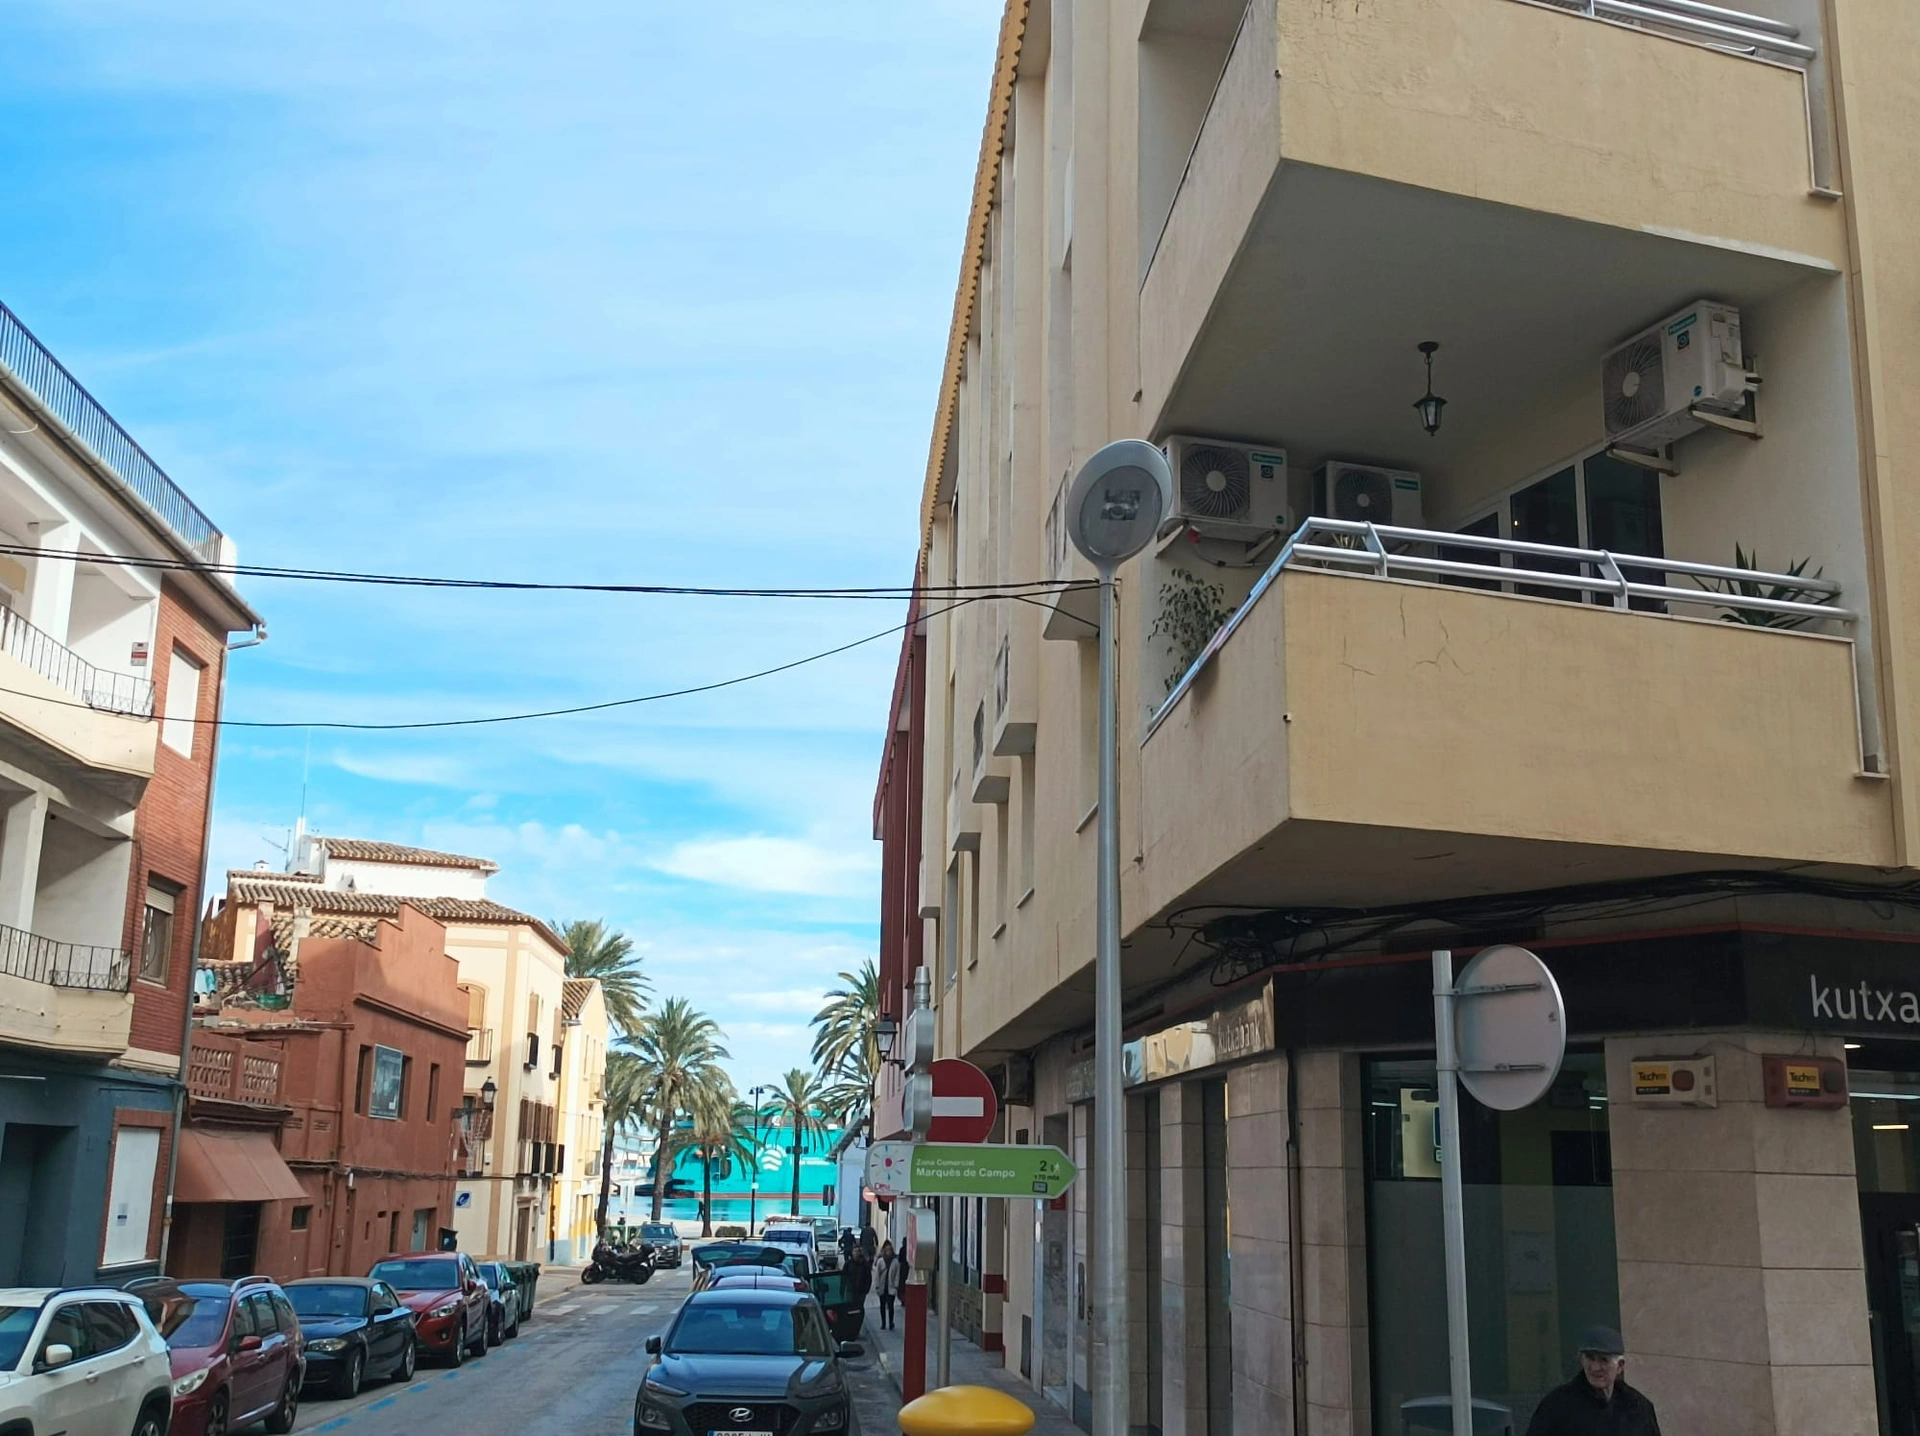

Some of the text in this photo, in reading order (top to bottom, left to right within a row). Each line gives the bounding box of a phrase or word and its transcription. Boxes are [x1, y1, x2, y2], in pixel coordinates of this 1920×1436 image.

[1810, 974, 1920, 1024] kutxa
[1218, 1012, 1261, 1053] kutxabank
[916, 1158, 975, 1167] Zona Comercial
[1039, 1160, 1048, 1172] 2
[963, 1167, 977, 1178] de
[978, 1168, 1016, 1180] Campo
